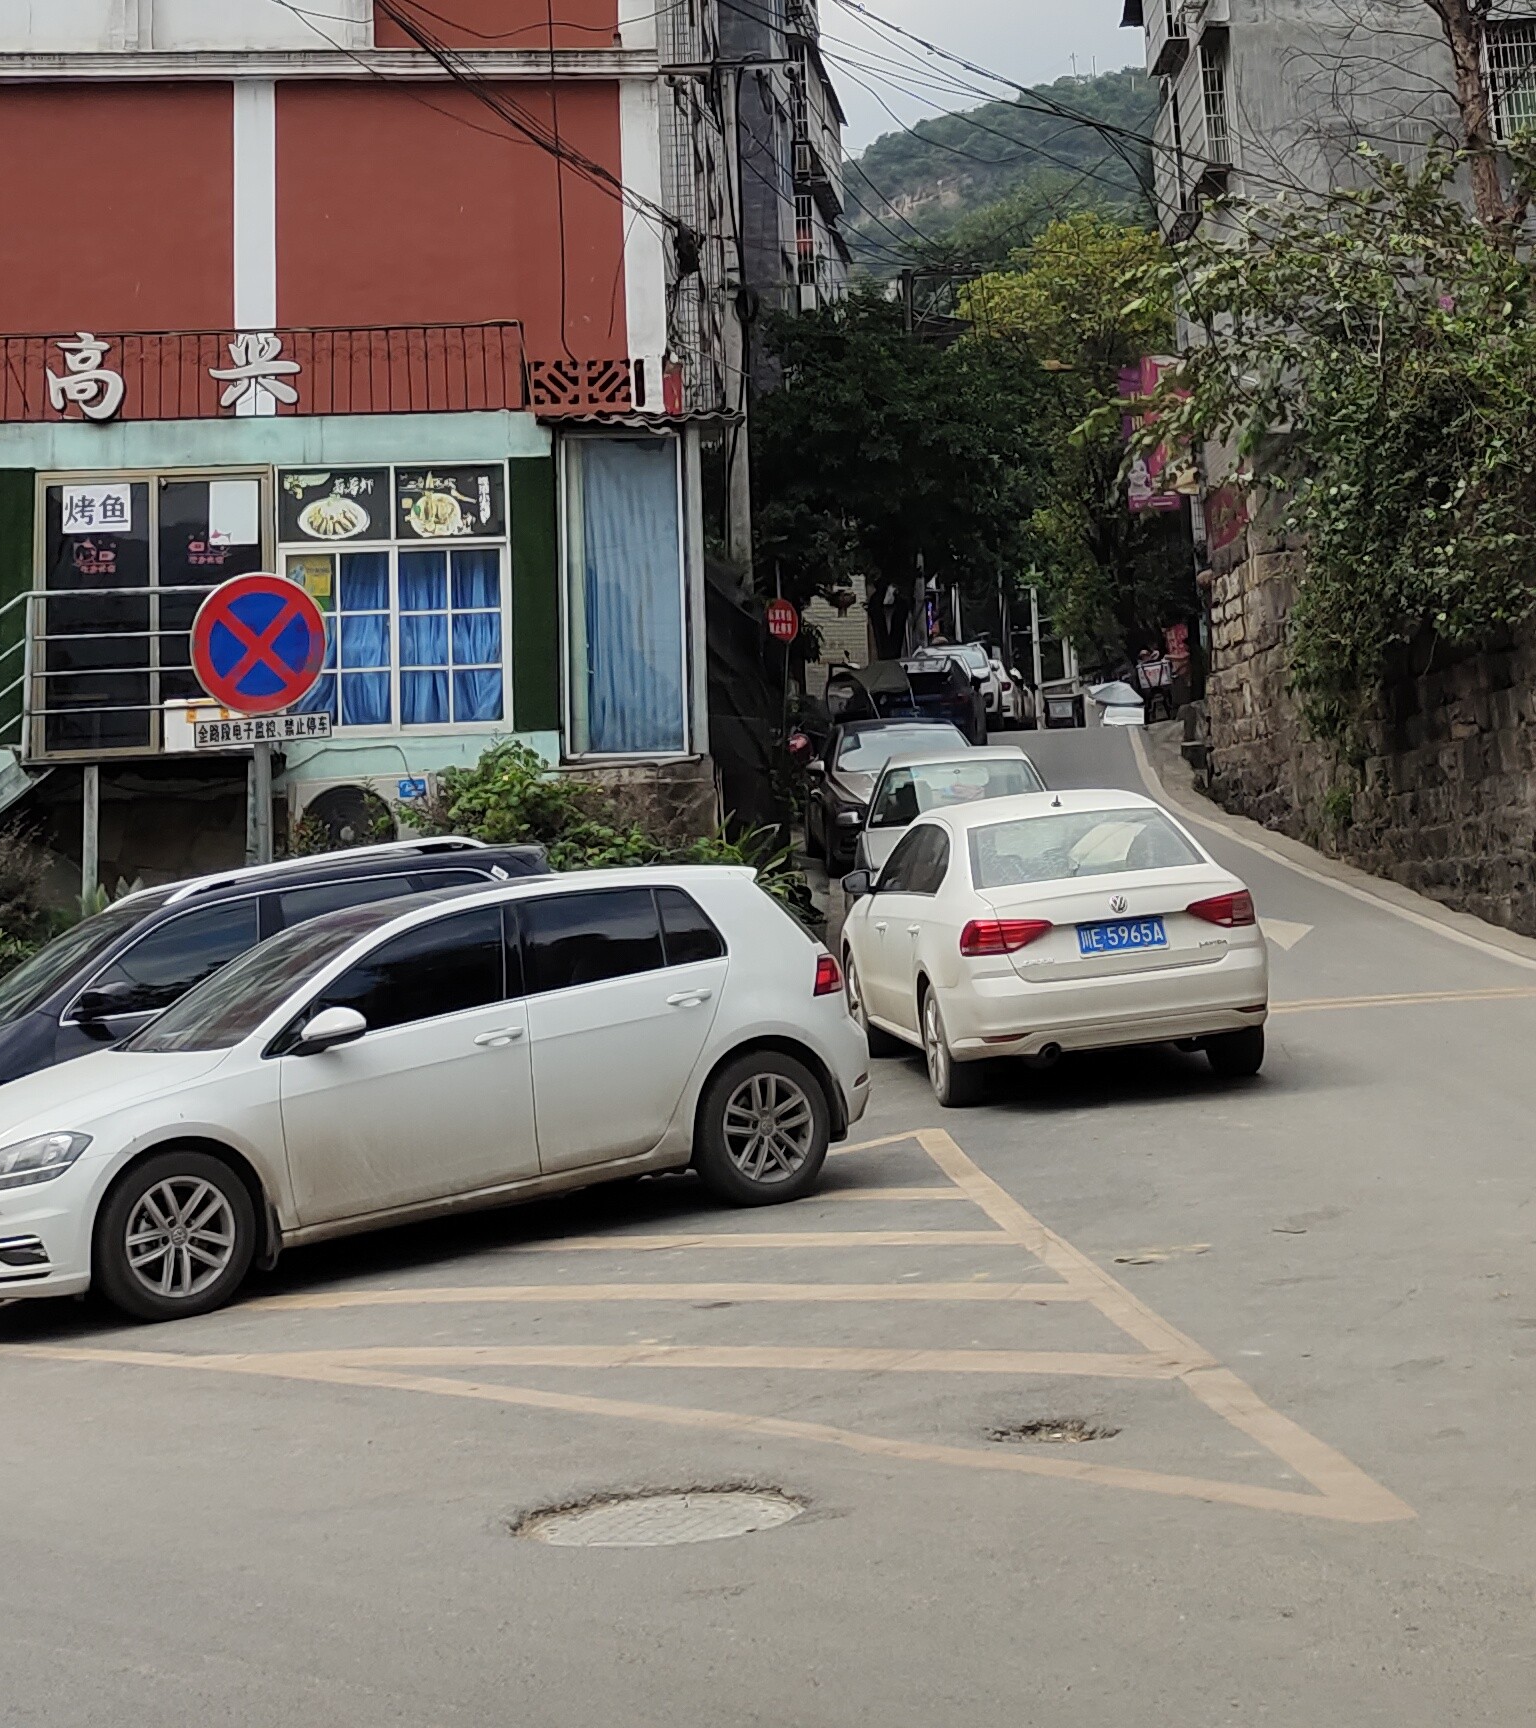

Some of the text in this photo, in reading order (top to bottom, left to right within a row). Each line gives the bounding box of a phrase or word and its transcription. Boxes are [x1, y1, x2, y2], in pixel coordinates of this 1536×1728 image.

[64, 493, 129, 526] 烤鱼
[198, 715, 328, 744] 全路段电子监控、禁止停车
